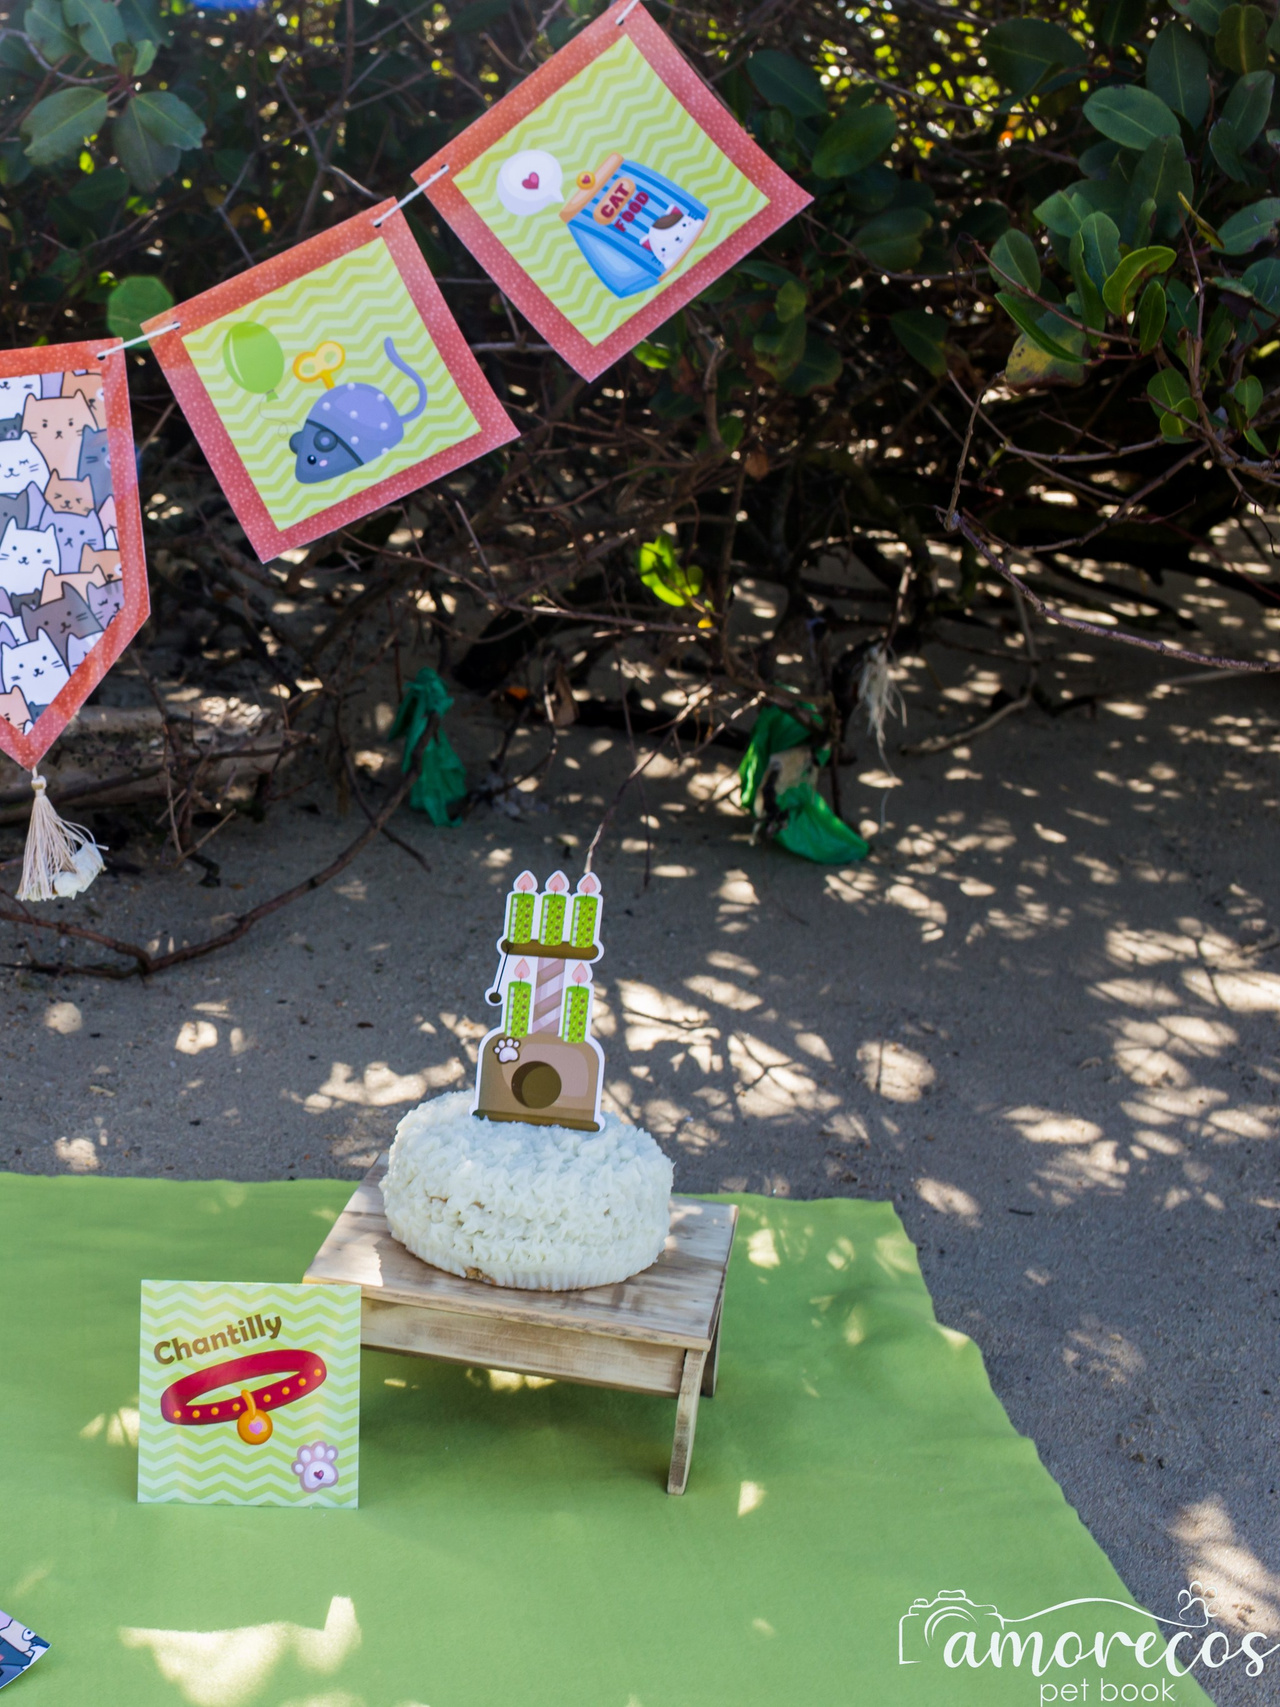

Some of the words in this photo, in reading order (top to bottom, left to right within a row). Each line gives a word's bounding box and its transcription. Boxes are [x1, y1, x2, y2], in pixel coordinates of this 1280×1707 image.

[601, 183, 630, 219] CAT
[614, 191, 649, 233] FOOD
[153, 1313, 282, 1365] Chantilly
